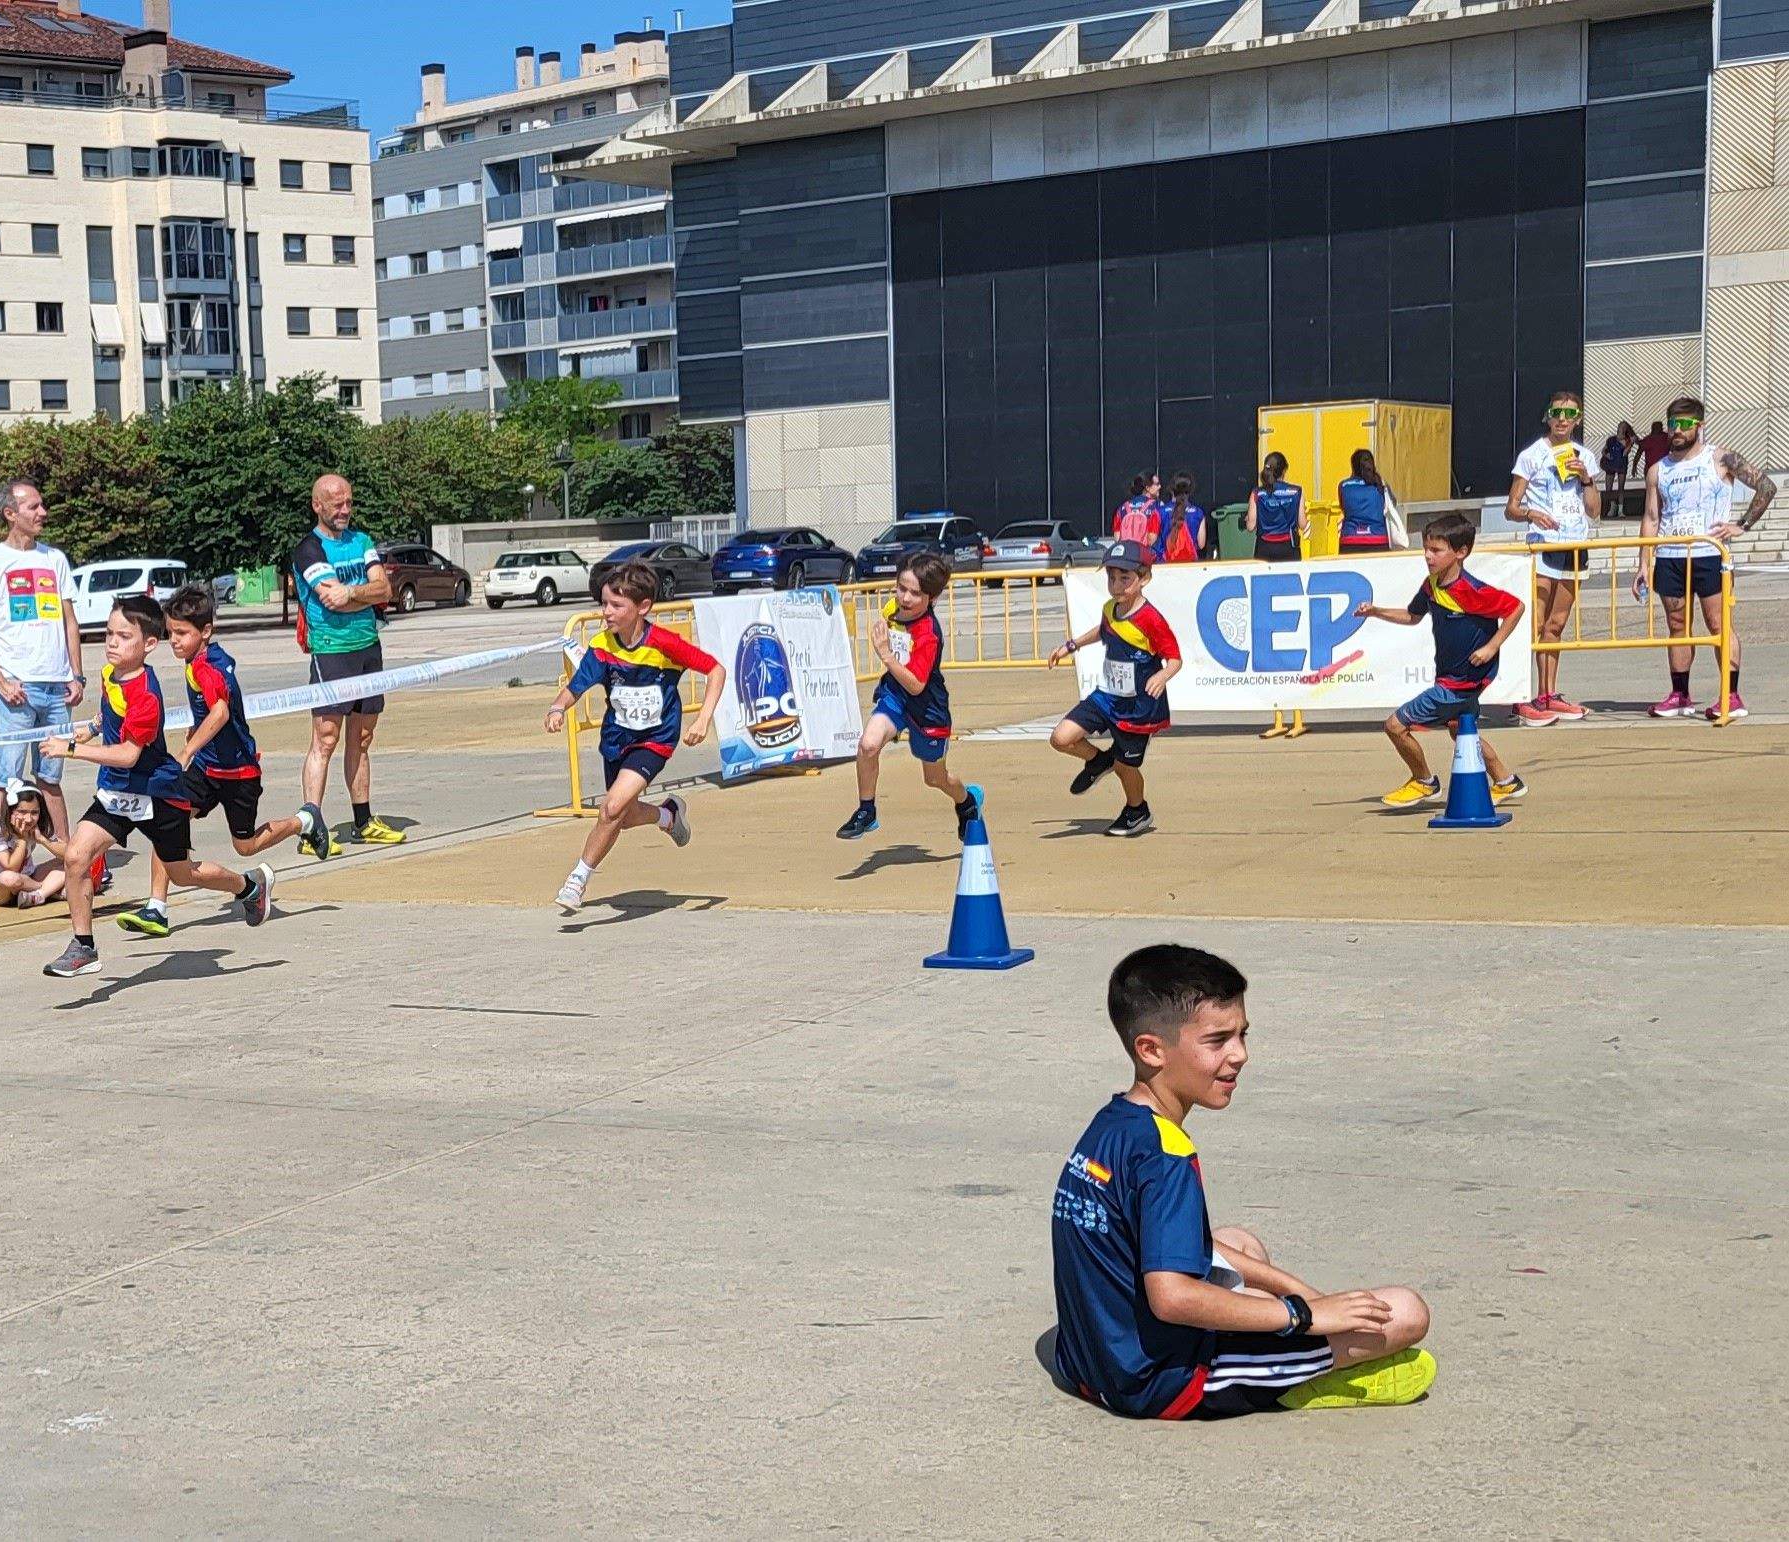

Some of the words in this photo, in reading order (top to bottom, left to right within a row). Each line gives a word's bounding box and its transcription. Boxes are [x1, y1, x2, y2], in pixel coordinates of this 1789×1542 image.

[1196, 571, 1373, 673] CEP
[1196, 674, 1271, 686] CONFEDERACIÓN
[1273, 672, 1321, 685] ESPAÑOLA
[1322, 672, 1335, 683] DE
[1337, 670, 1375, 683] POLICÍA
